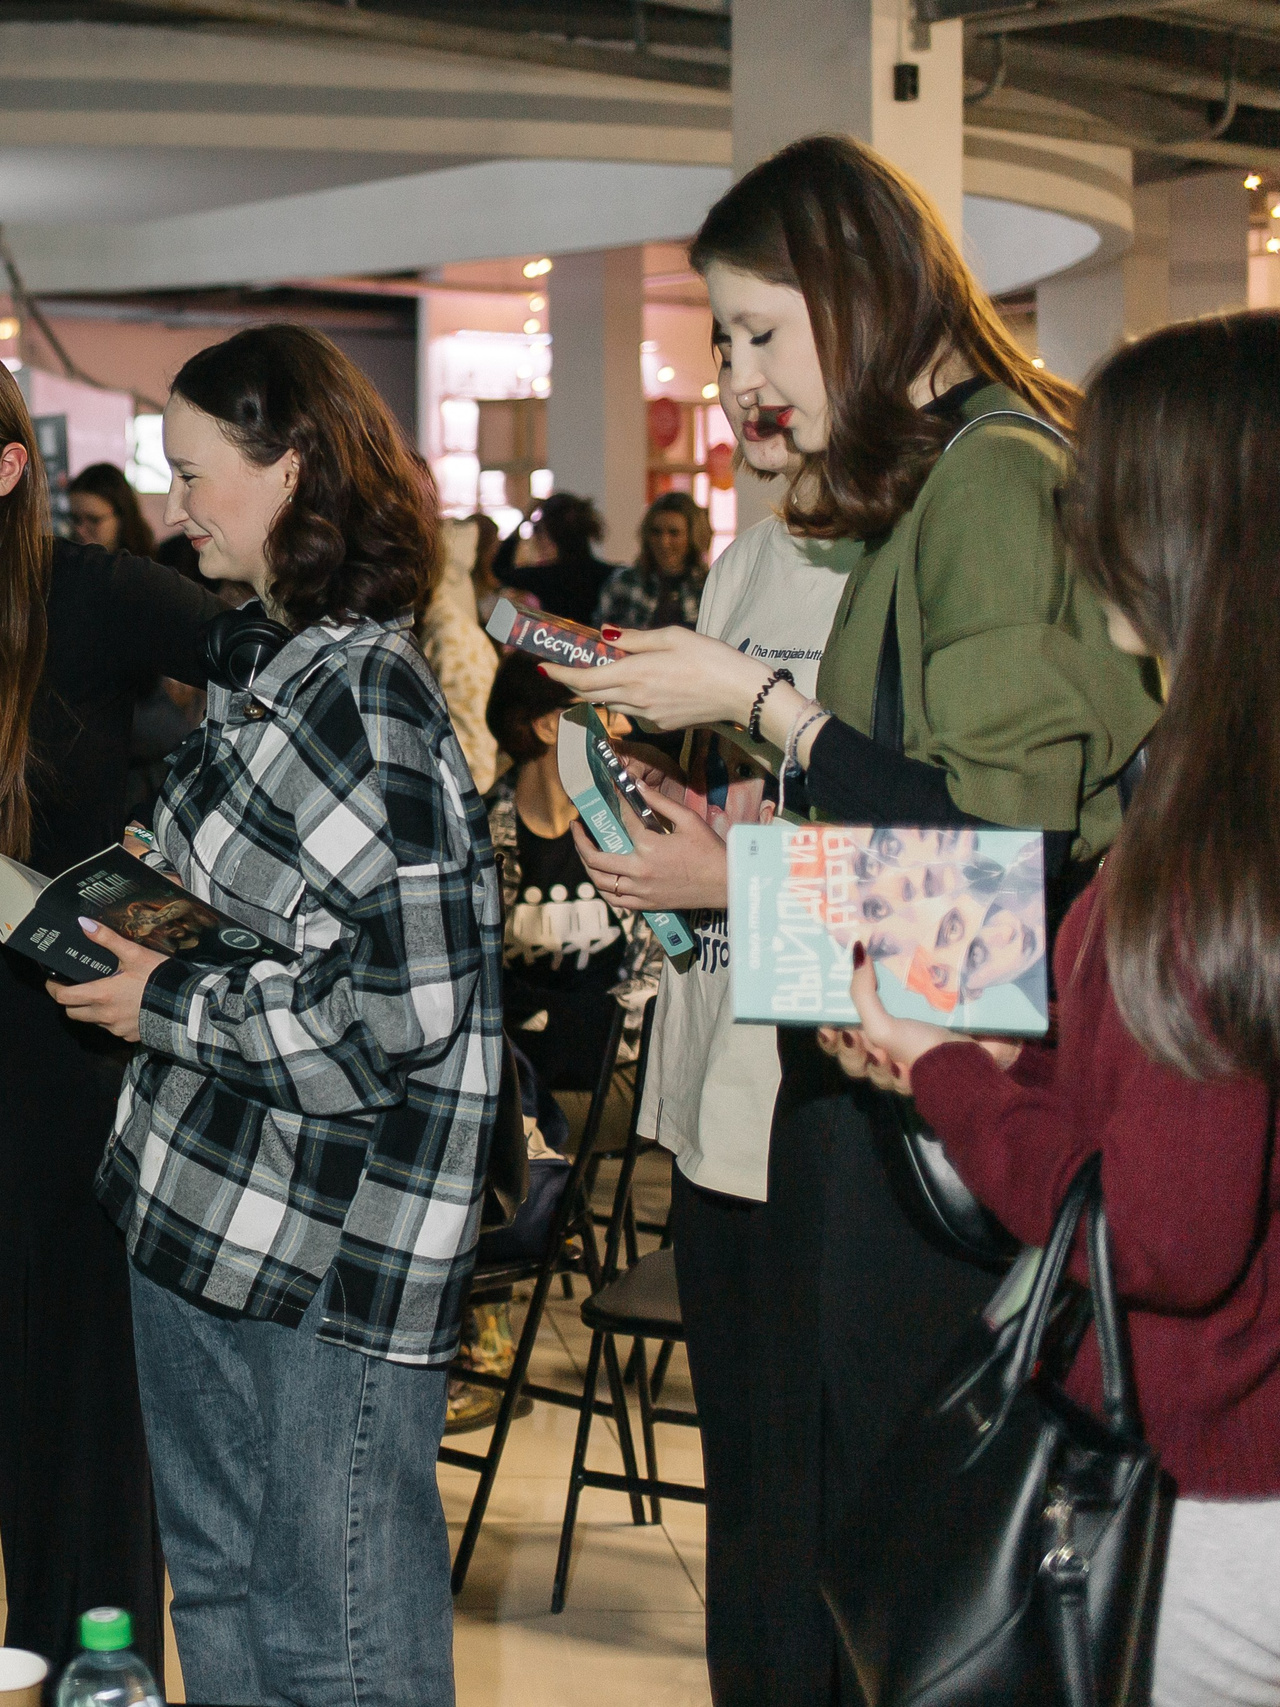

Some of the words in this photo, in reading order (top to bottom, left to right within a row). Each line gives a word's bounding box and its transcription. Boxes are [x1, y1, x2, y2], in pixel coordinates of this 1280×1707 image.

[780, 829, 819, 865] ИЗ
[78, 954, 92, 966] ГДЕ
[771, 877, 826, 1013] ВЫЙДИ
